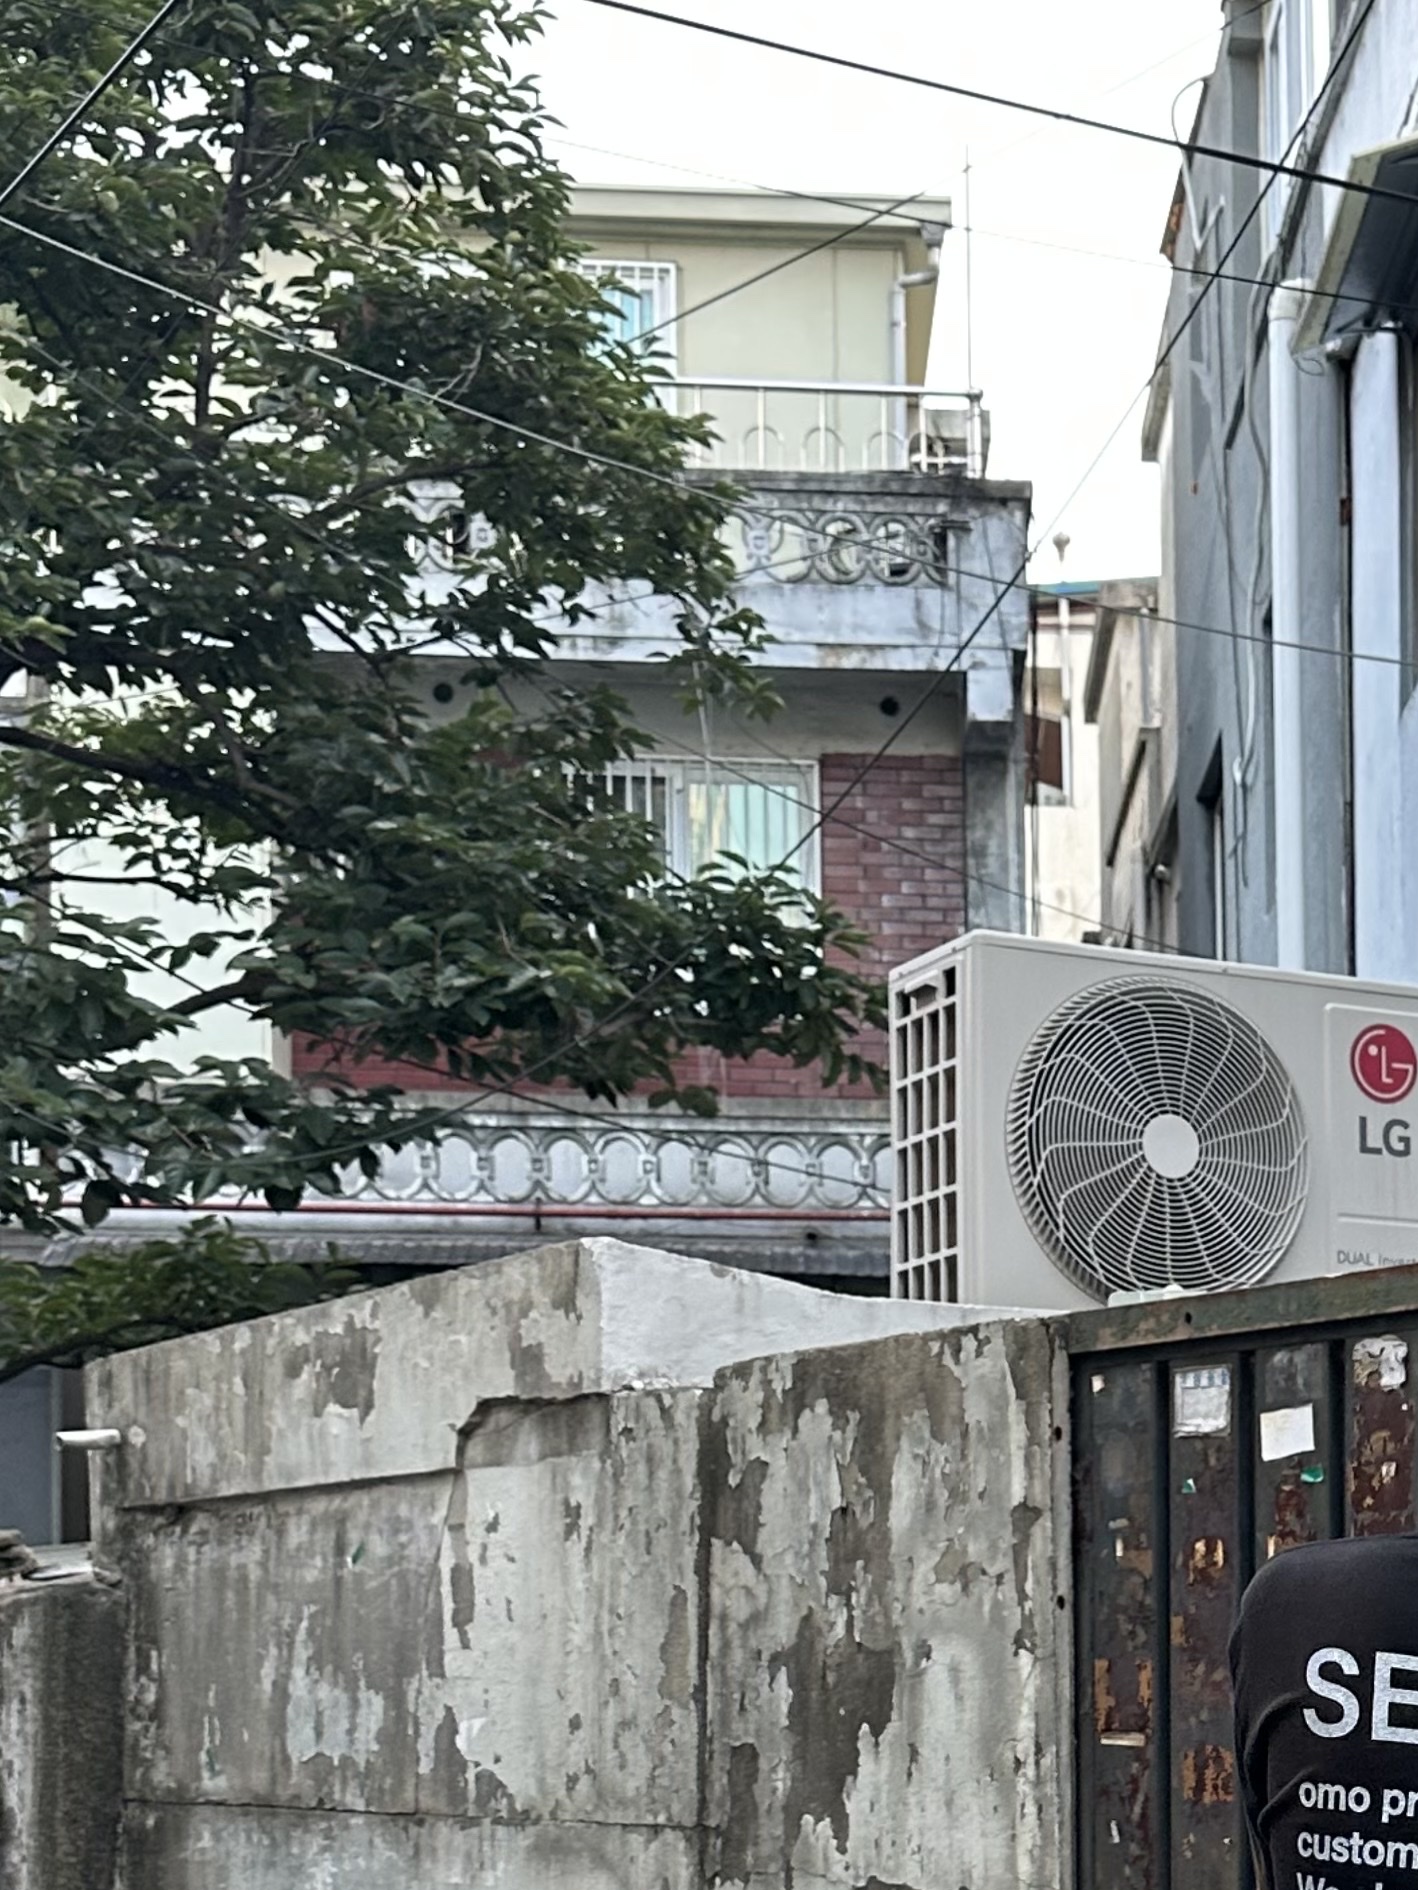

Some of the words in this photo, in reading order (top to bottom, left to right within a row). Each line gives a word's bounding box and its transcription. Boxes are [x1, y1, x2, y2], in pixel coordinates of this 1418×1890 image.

[1359, 1115, 1411, 1157] LG
[1337, 1250, 1374, 1266] DUAL
[1298, 1781, 1371, 1813] omo
